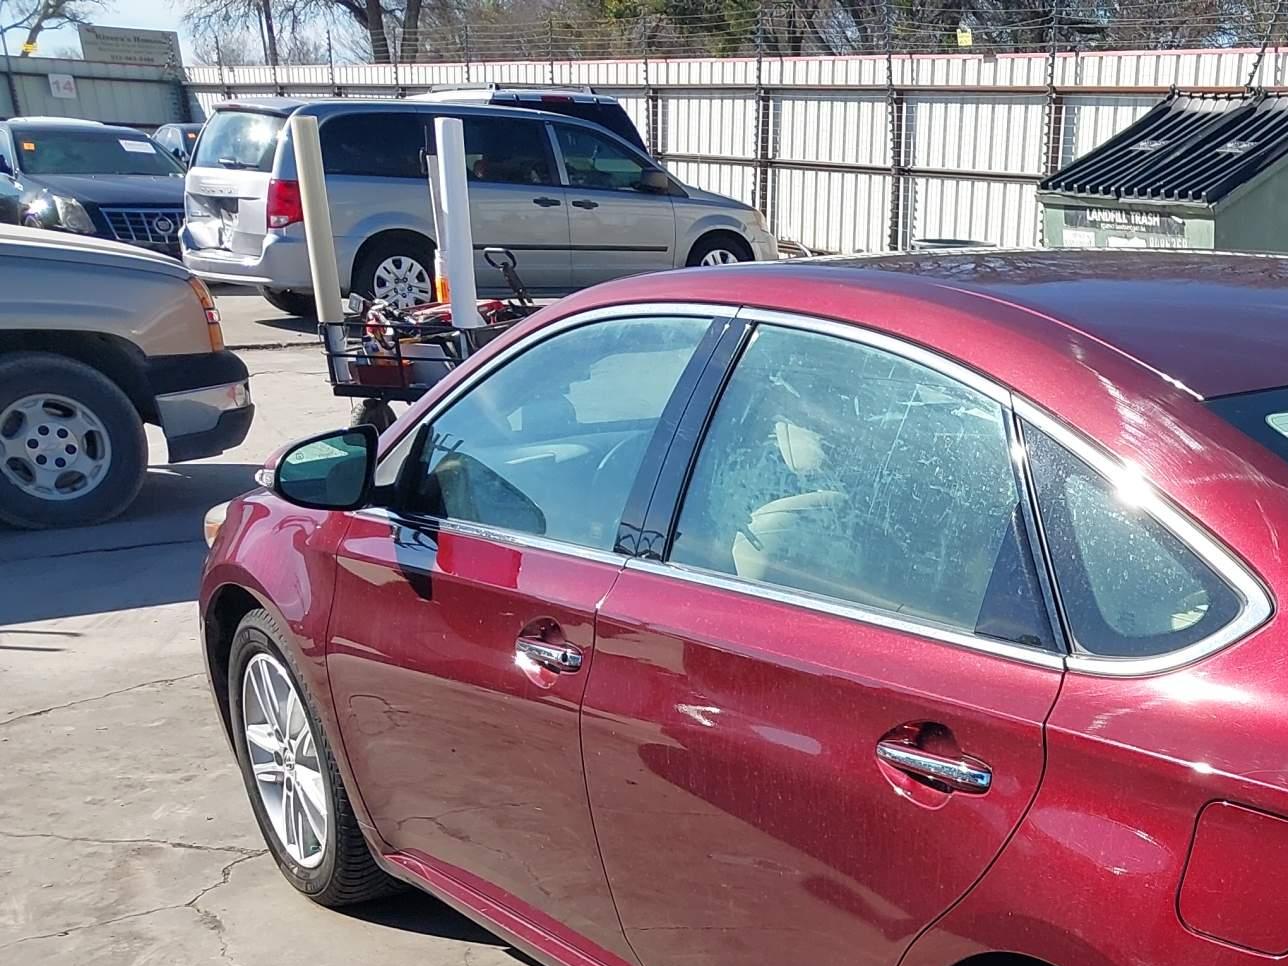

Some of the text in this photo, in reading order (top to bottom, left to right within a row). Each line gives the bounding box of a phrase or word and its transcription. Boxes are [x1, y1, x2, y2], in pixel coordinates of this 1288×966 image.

[52, 79, 75, 93] 14
[1086, 208, 1128, 225] LANDFILL
[1130, 211, 1160, 227] TRASH
